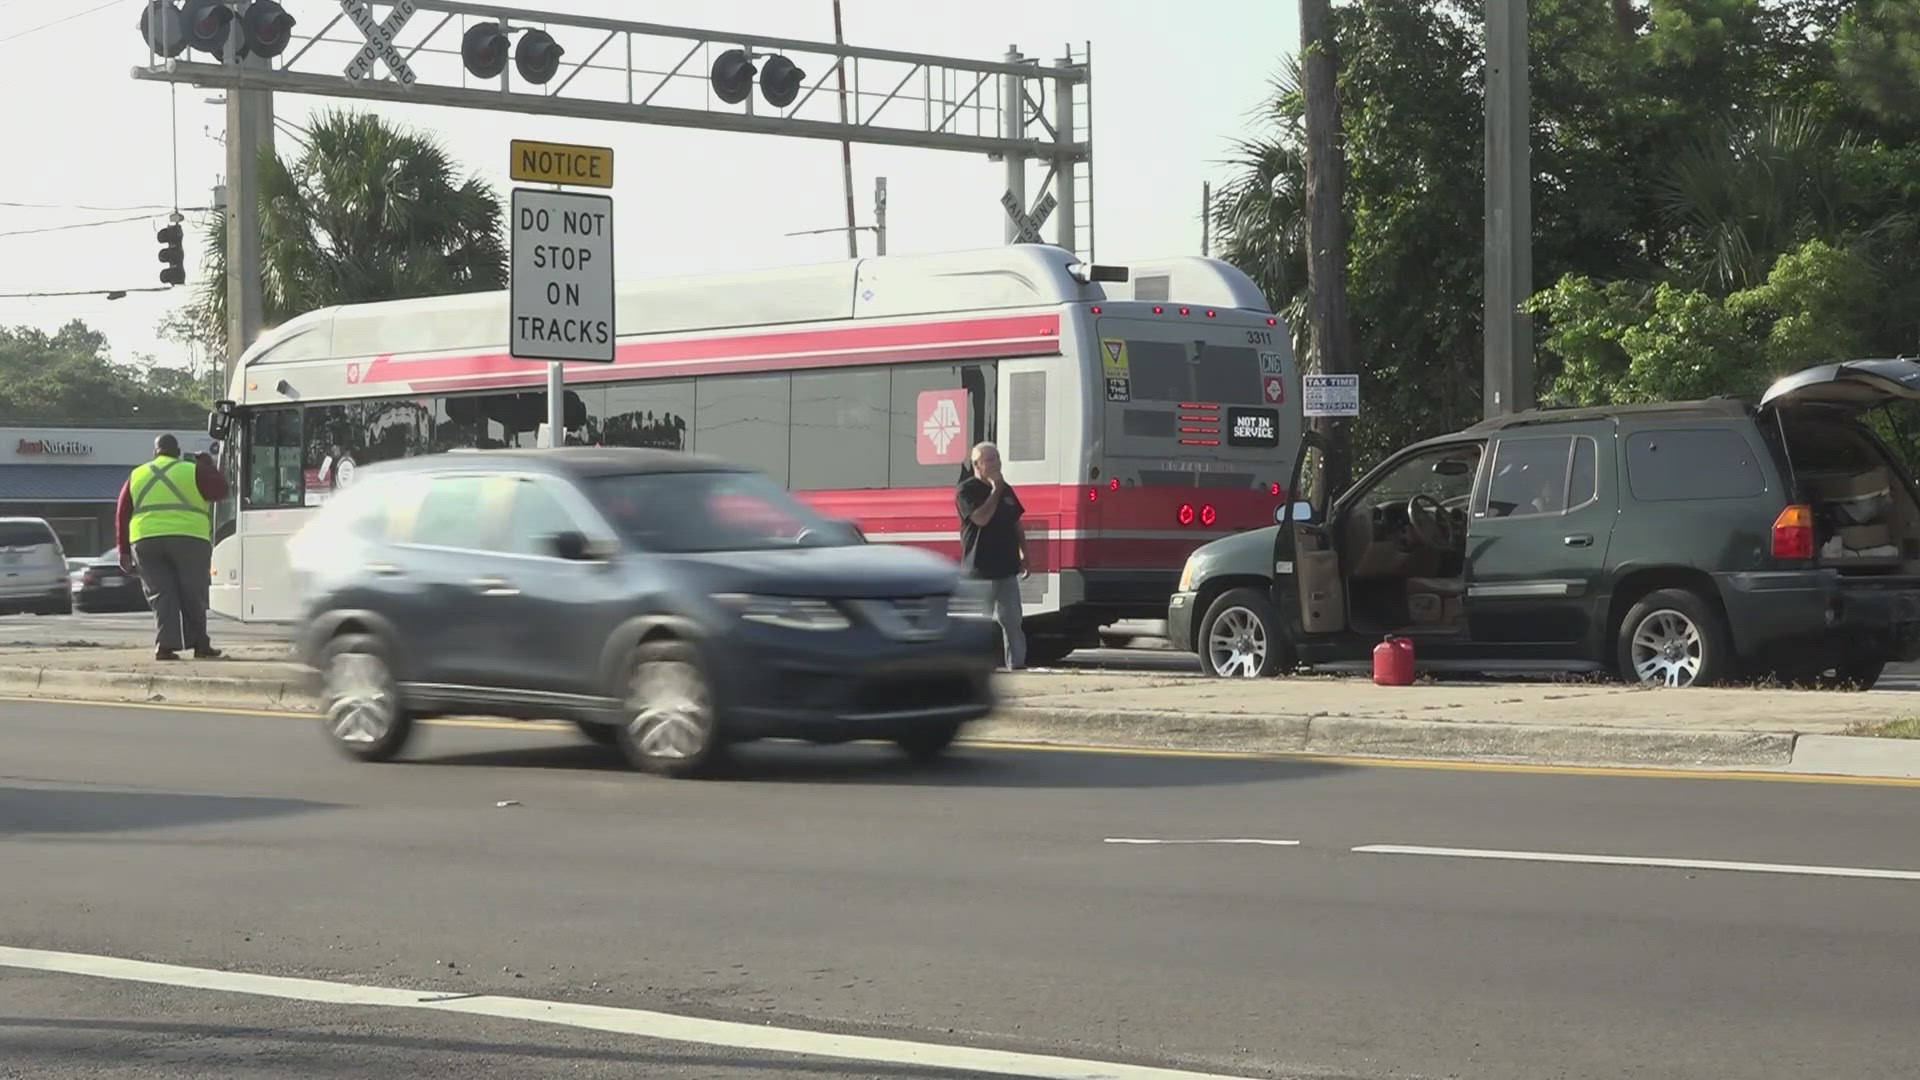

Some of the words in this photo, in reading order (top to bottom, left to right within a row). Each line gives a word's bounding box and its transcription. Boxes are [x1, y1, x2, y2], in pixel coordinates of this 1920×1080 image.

[348, 1, 412, 80] CROSSING
[522, 149, 601, 178] NOTICE
[521, 208, 549, 232] DO
[563, 211, 604, 236] NOT
[533, 245, 591, 270] STOP
[547, 282, 579, 306] ON
[518, 316, 608, 344] TRACKS
[1246, 330, 1272, 345] 3311
[1262, 354, 1280, 372] CNG
[1330, 378, 1355, 386] TIME
[1233, 427, 1274, 438] SERVICE
[1237, 416, 1257, 428] NOT
[1258, 417, 1270, 428] IN
